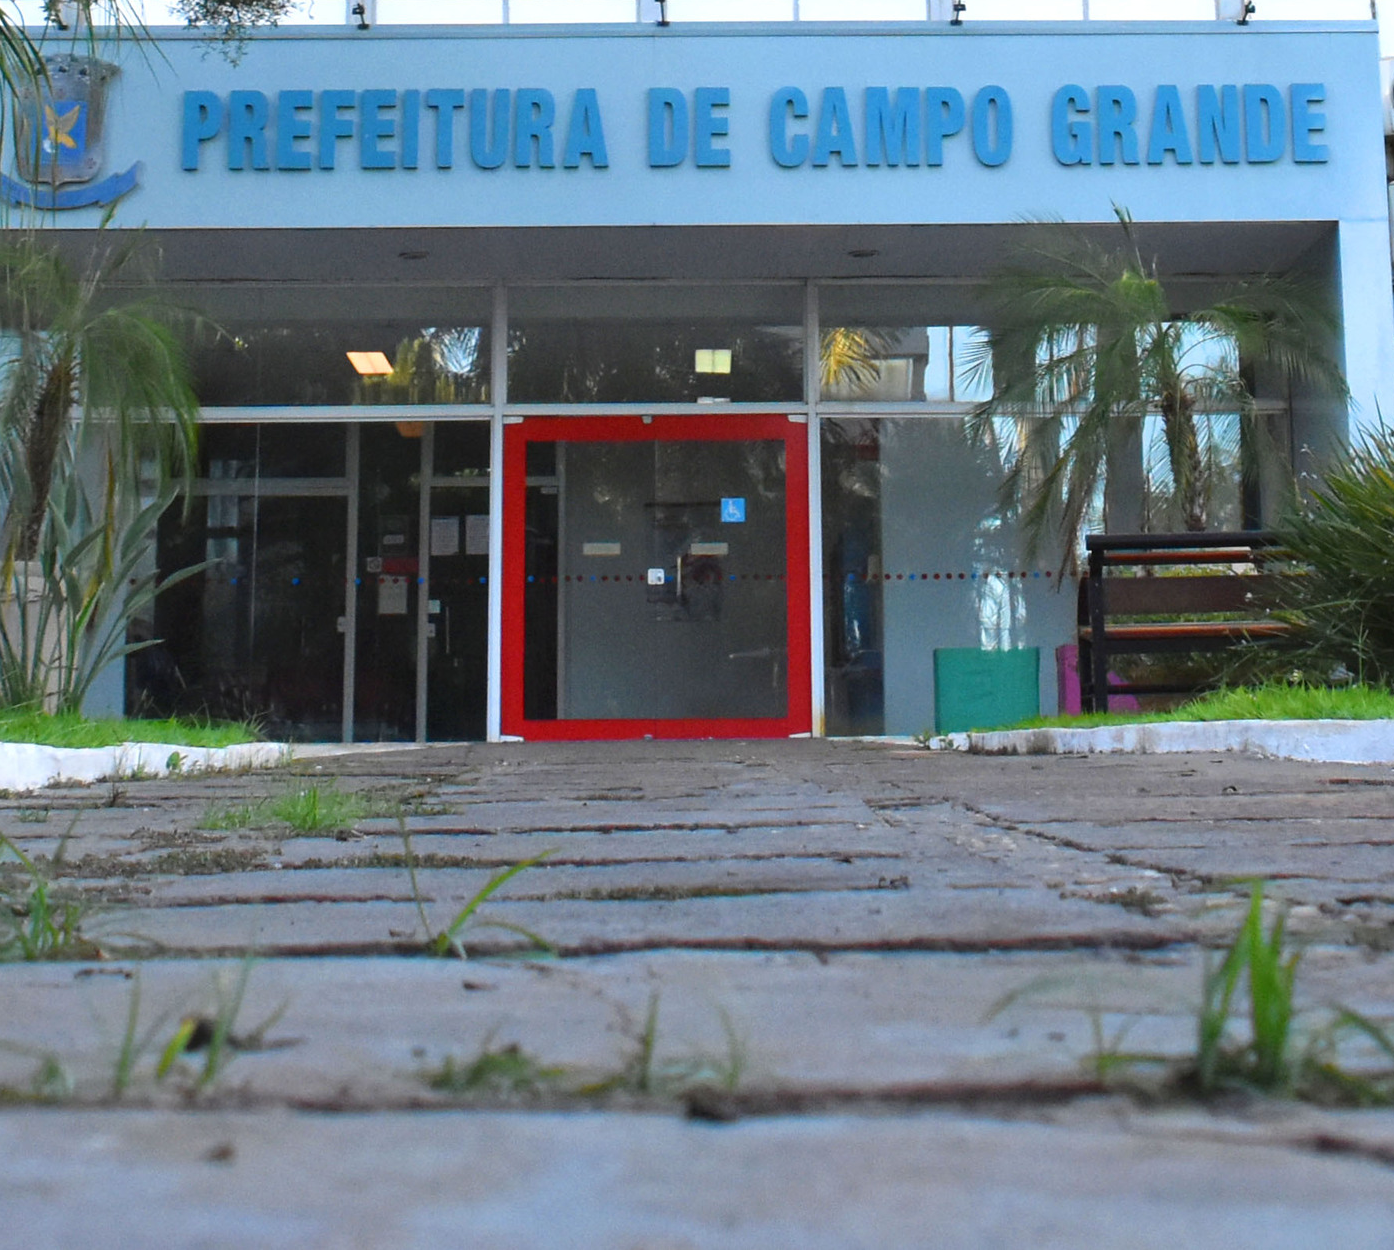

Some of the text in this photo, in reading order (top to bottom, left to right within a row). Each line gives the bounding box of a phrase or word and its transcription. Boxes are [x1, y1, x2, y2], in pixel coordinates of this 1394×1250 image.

[181, 83, 1330, 172] PREFEITURA DE CAMPO GRANDE
